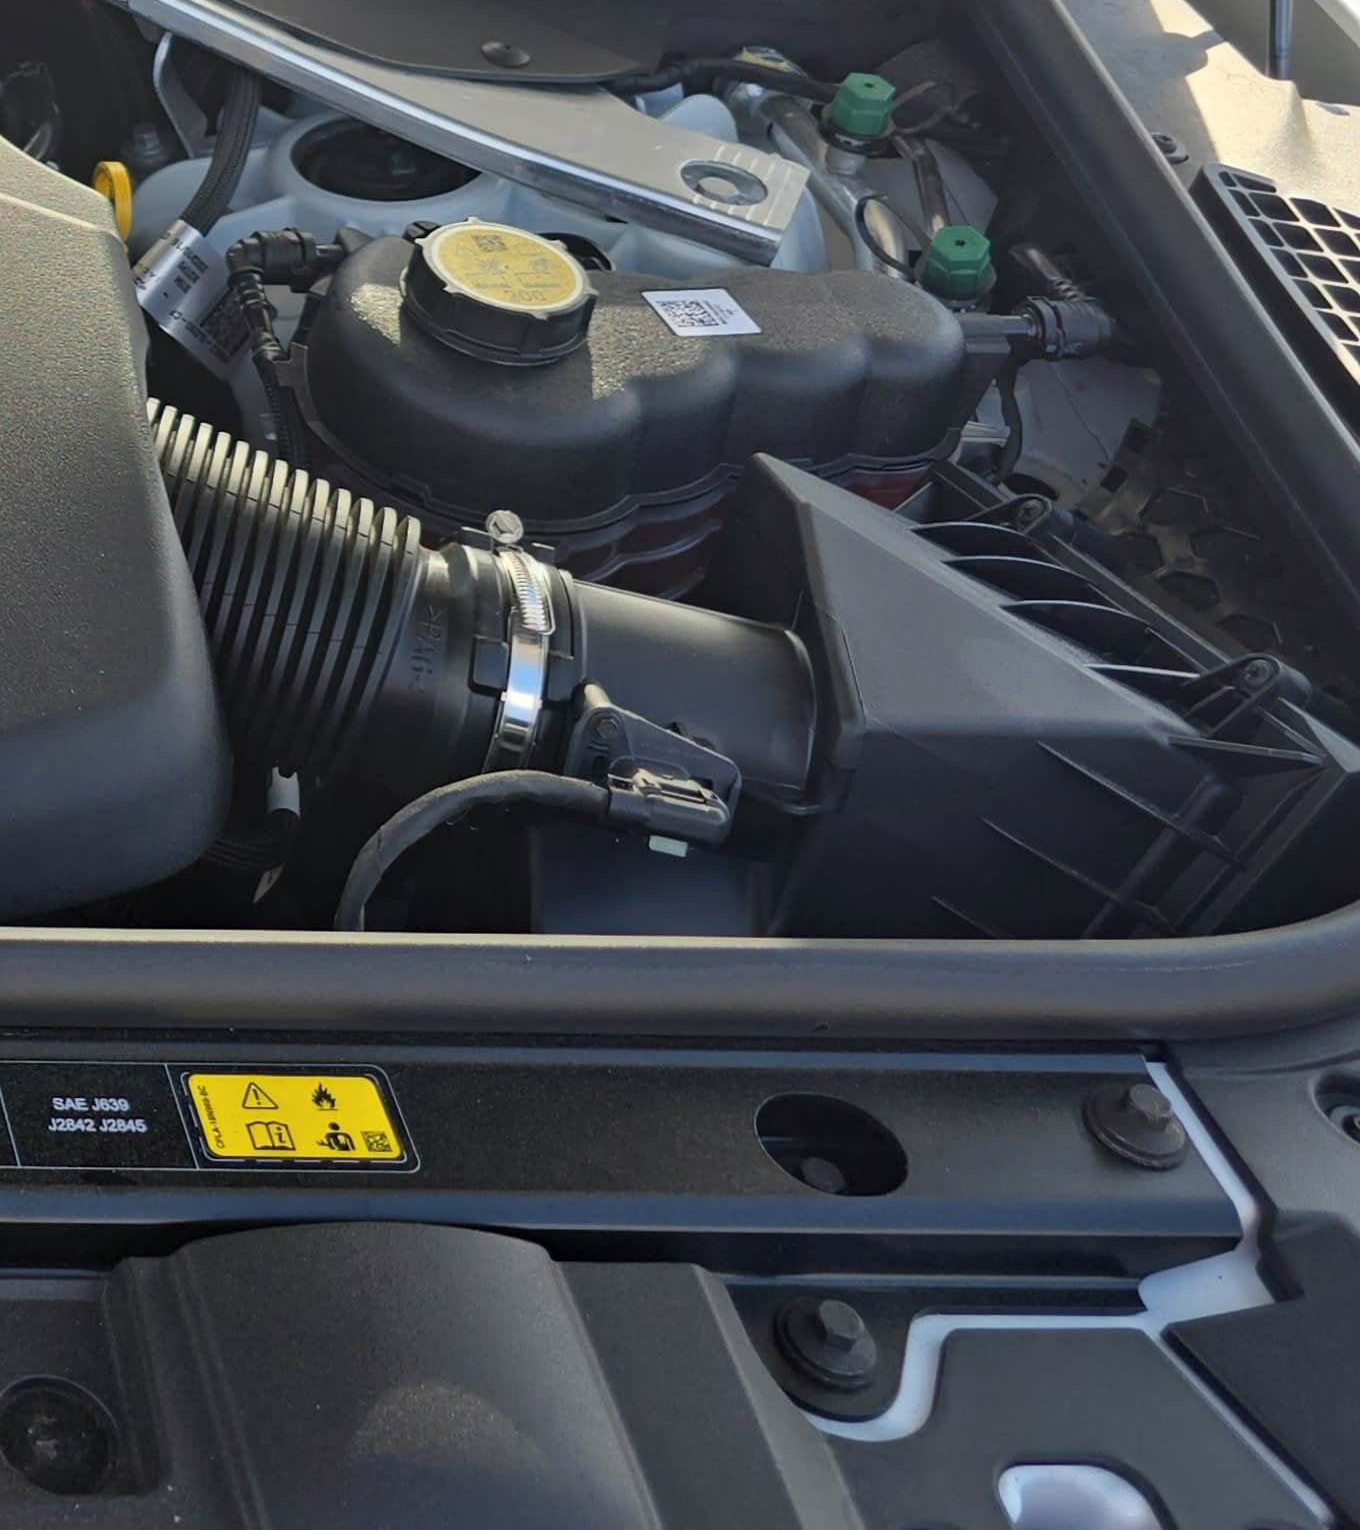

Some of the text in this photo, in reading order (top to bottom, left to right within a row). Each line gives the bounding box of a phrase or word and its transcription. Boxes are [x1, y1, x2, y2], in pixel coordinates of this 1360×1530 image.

[52, 1097, 130, 1111] SAE J639
[48, 1118, 147, 1133] J2842 J2845
